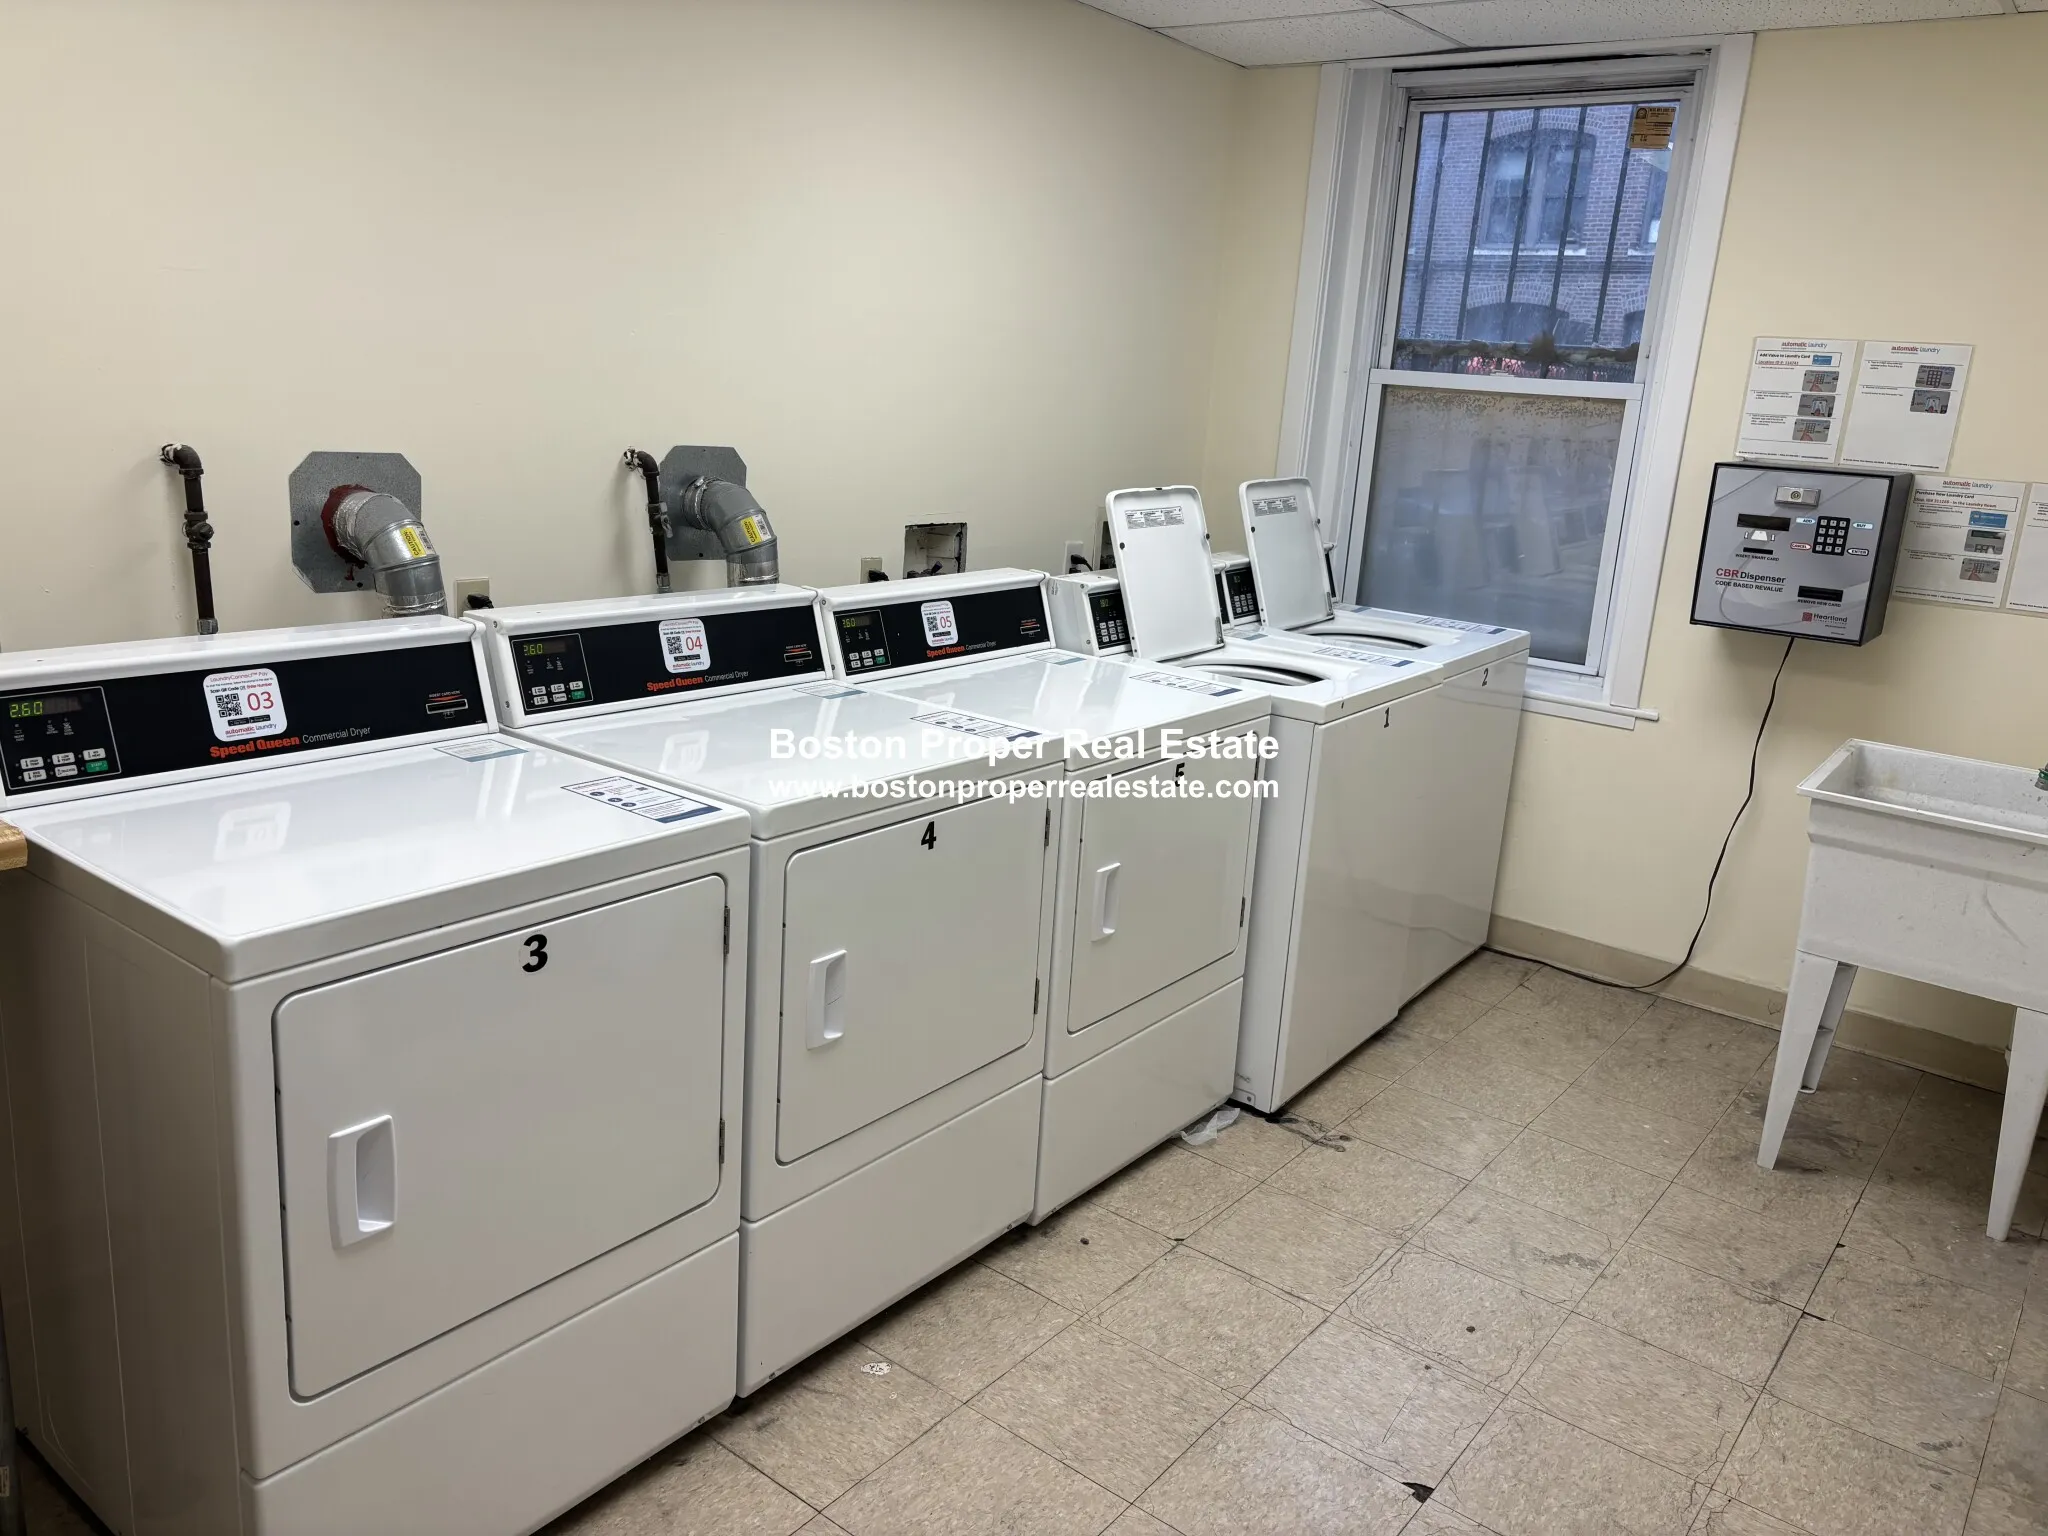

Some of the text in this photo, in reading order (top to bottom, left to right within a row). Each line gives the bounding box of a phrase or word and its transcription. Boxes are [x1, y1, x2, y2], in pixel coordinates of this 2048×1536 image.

[1972, 482, 1994, 490] laundry
[1716, 568, 1786, 584] CBR Dispenser
[940, 616, 952, 628] 05
[1814, 612, 1848, 623] Heartland
[686, 636, 702, 651] 04
[926, 647, 946, 658] Speed
[646, 680, 676, 692] Speed
[676, 676, 703, 686] Queen
[704, 672, 734, 682] Commercial
[1481, 668, 1489, 687] 2
[10, 701, 43, 718] 2.60
[247, 691, 274, 712] 03
[1383, 706, 1390, 728] 1
[225, 726, 255, 735] automatic
[256, 723, 277, 731] laundry
[210, 726, 371, 758] Speed Queen Commercial Dryer
[1174, 762, 1186, 787] 5
[920, 821, 937, 850] 4
[521, 933, 549, 973] 3
